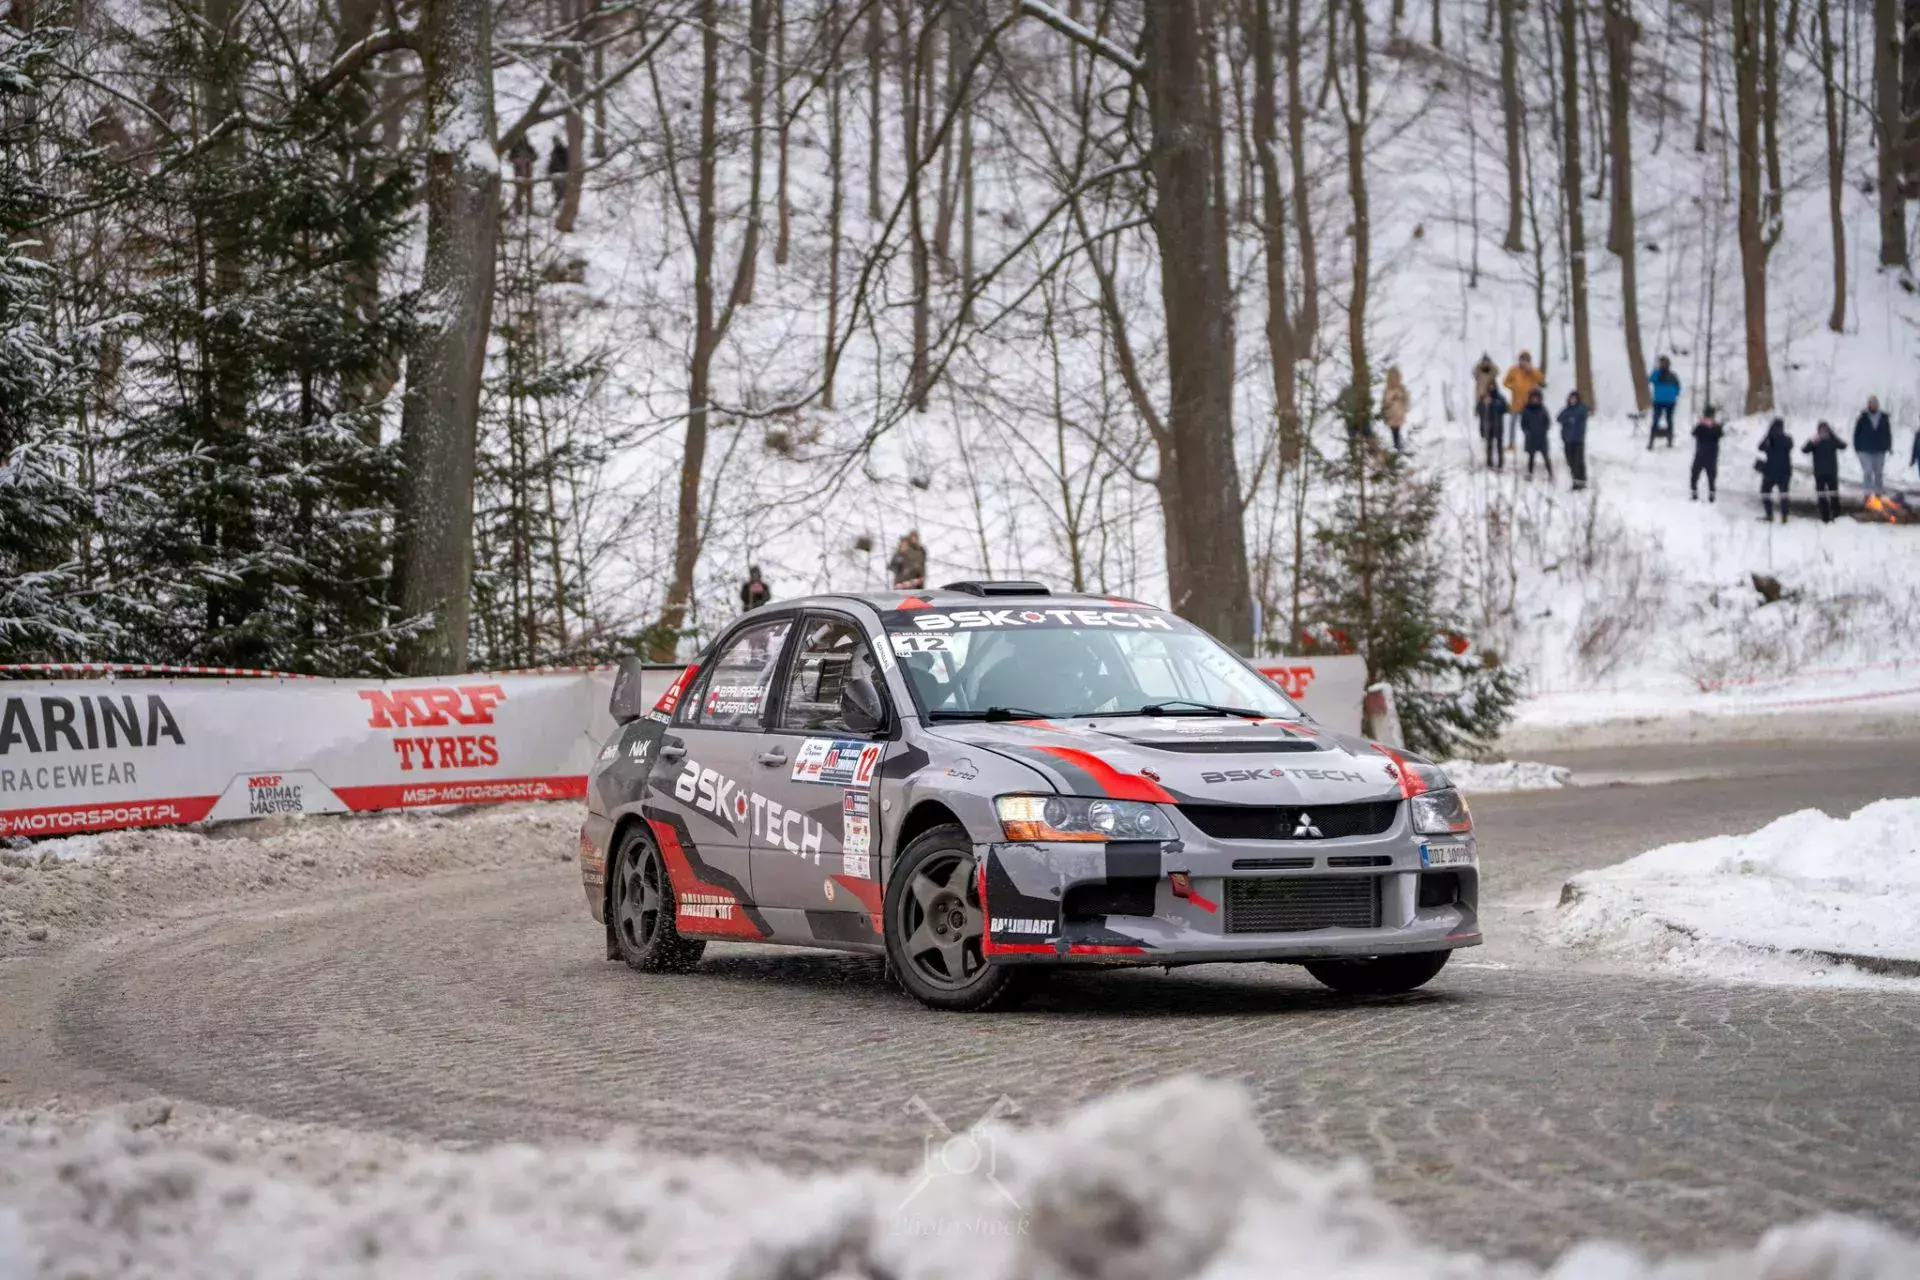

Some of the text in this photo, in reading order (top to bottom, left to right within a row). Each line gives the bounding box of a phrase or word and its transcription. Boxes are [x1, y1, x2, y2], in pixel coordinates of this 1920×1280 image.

[913, 609, 1174, 631] BSK TECH
[902, 637, 949, 651] 12
[357, 684, 507, 728] MRF
[0, 694, 186, 755] ARINA
[393, 735, 500, 771] TYRES
[857, 747, 879, 782] 12
[2, 762, 137, 793] RACEWEAR
[247, 775, 283, 788] MRF
[1201, 768, 1367, 784] BSK TECH
[248, 785, 303, 801] TARMAC
[402, 782, 554, 805] MSP-MOTORSPORT.PL
[249, 799, 305, 815] MASTERS
[675, 760, 736, 823] BSK
[750, 792, 823, 867] TECH
